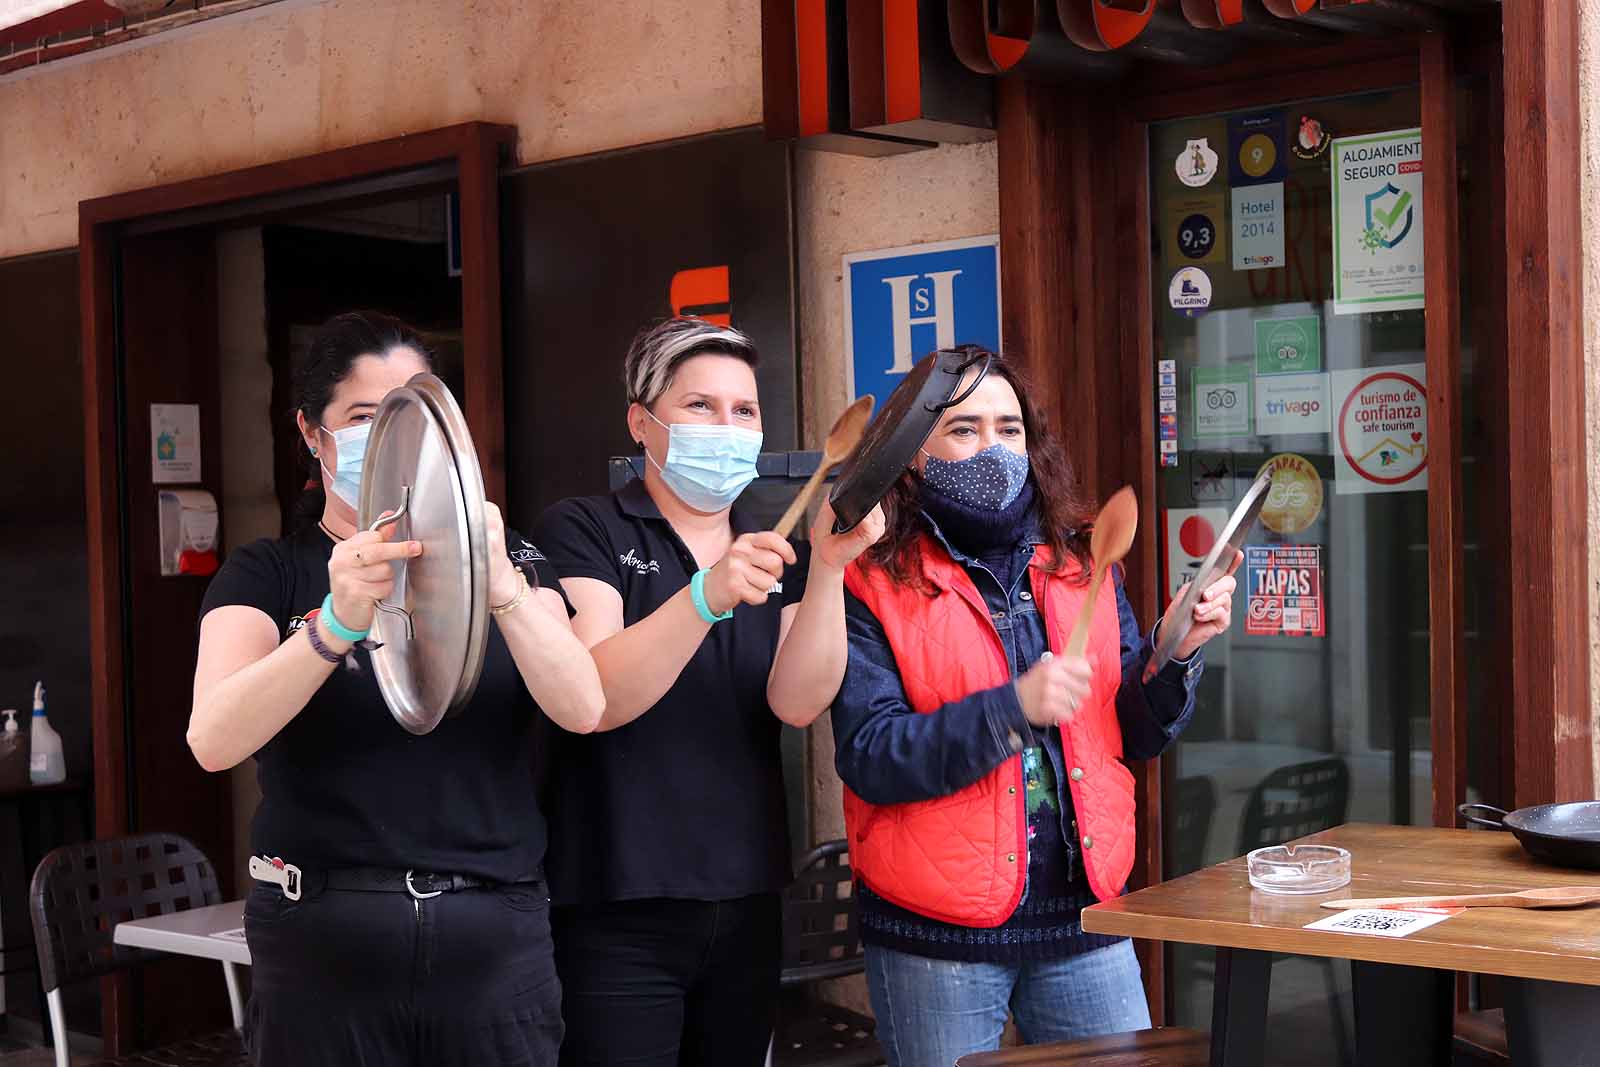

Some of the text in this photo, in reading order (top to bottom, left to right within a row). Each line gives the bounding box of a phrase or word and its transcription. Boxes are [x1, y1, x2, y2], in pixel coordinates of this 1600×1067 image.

[1343, 142, 1421, 162] ALOJAMIENT
[1344, 164, 1396, 181] SEGURO
[1241, 200, 1274, 215] Hotel
[1182, 228, 1210, 248] 9,3
[1241, 222, 1274, 238] 2014
[1360, 389, 1416, 406] turismo de
[1266, 400, 1320, 416] trivago
[1355, 404, 1421, 423] confianza
[1362, 420, 1414, 433] safe tourism
[1256, 569, 1310, 595] TAPAS
